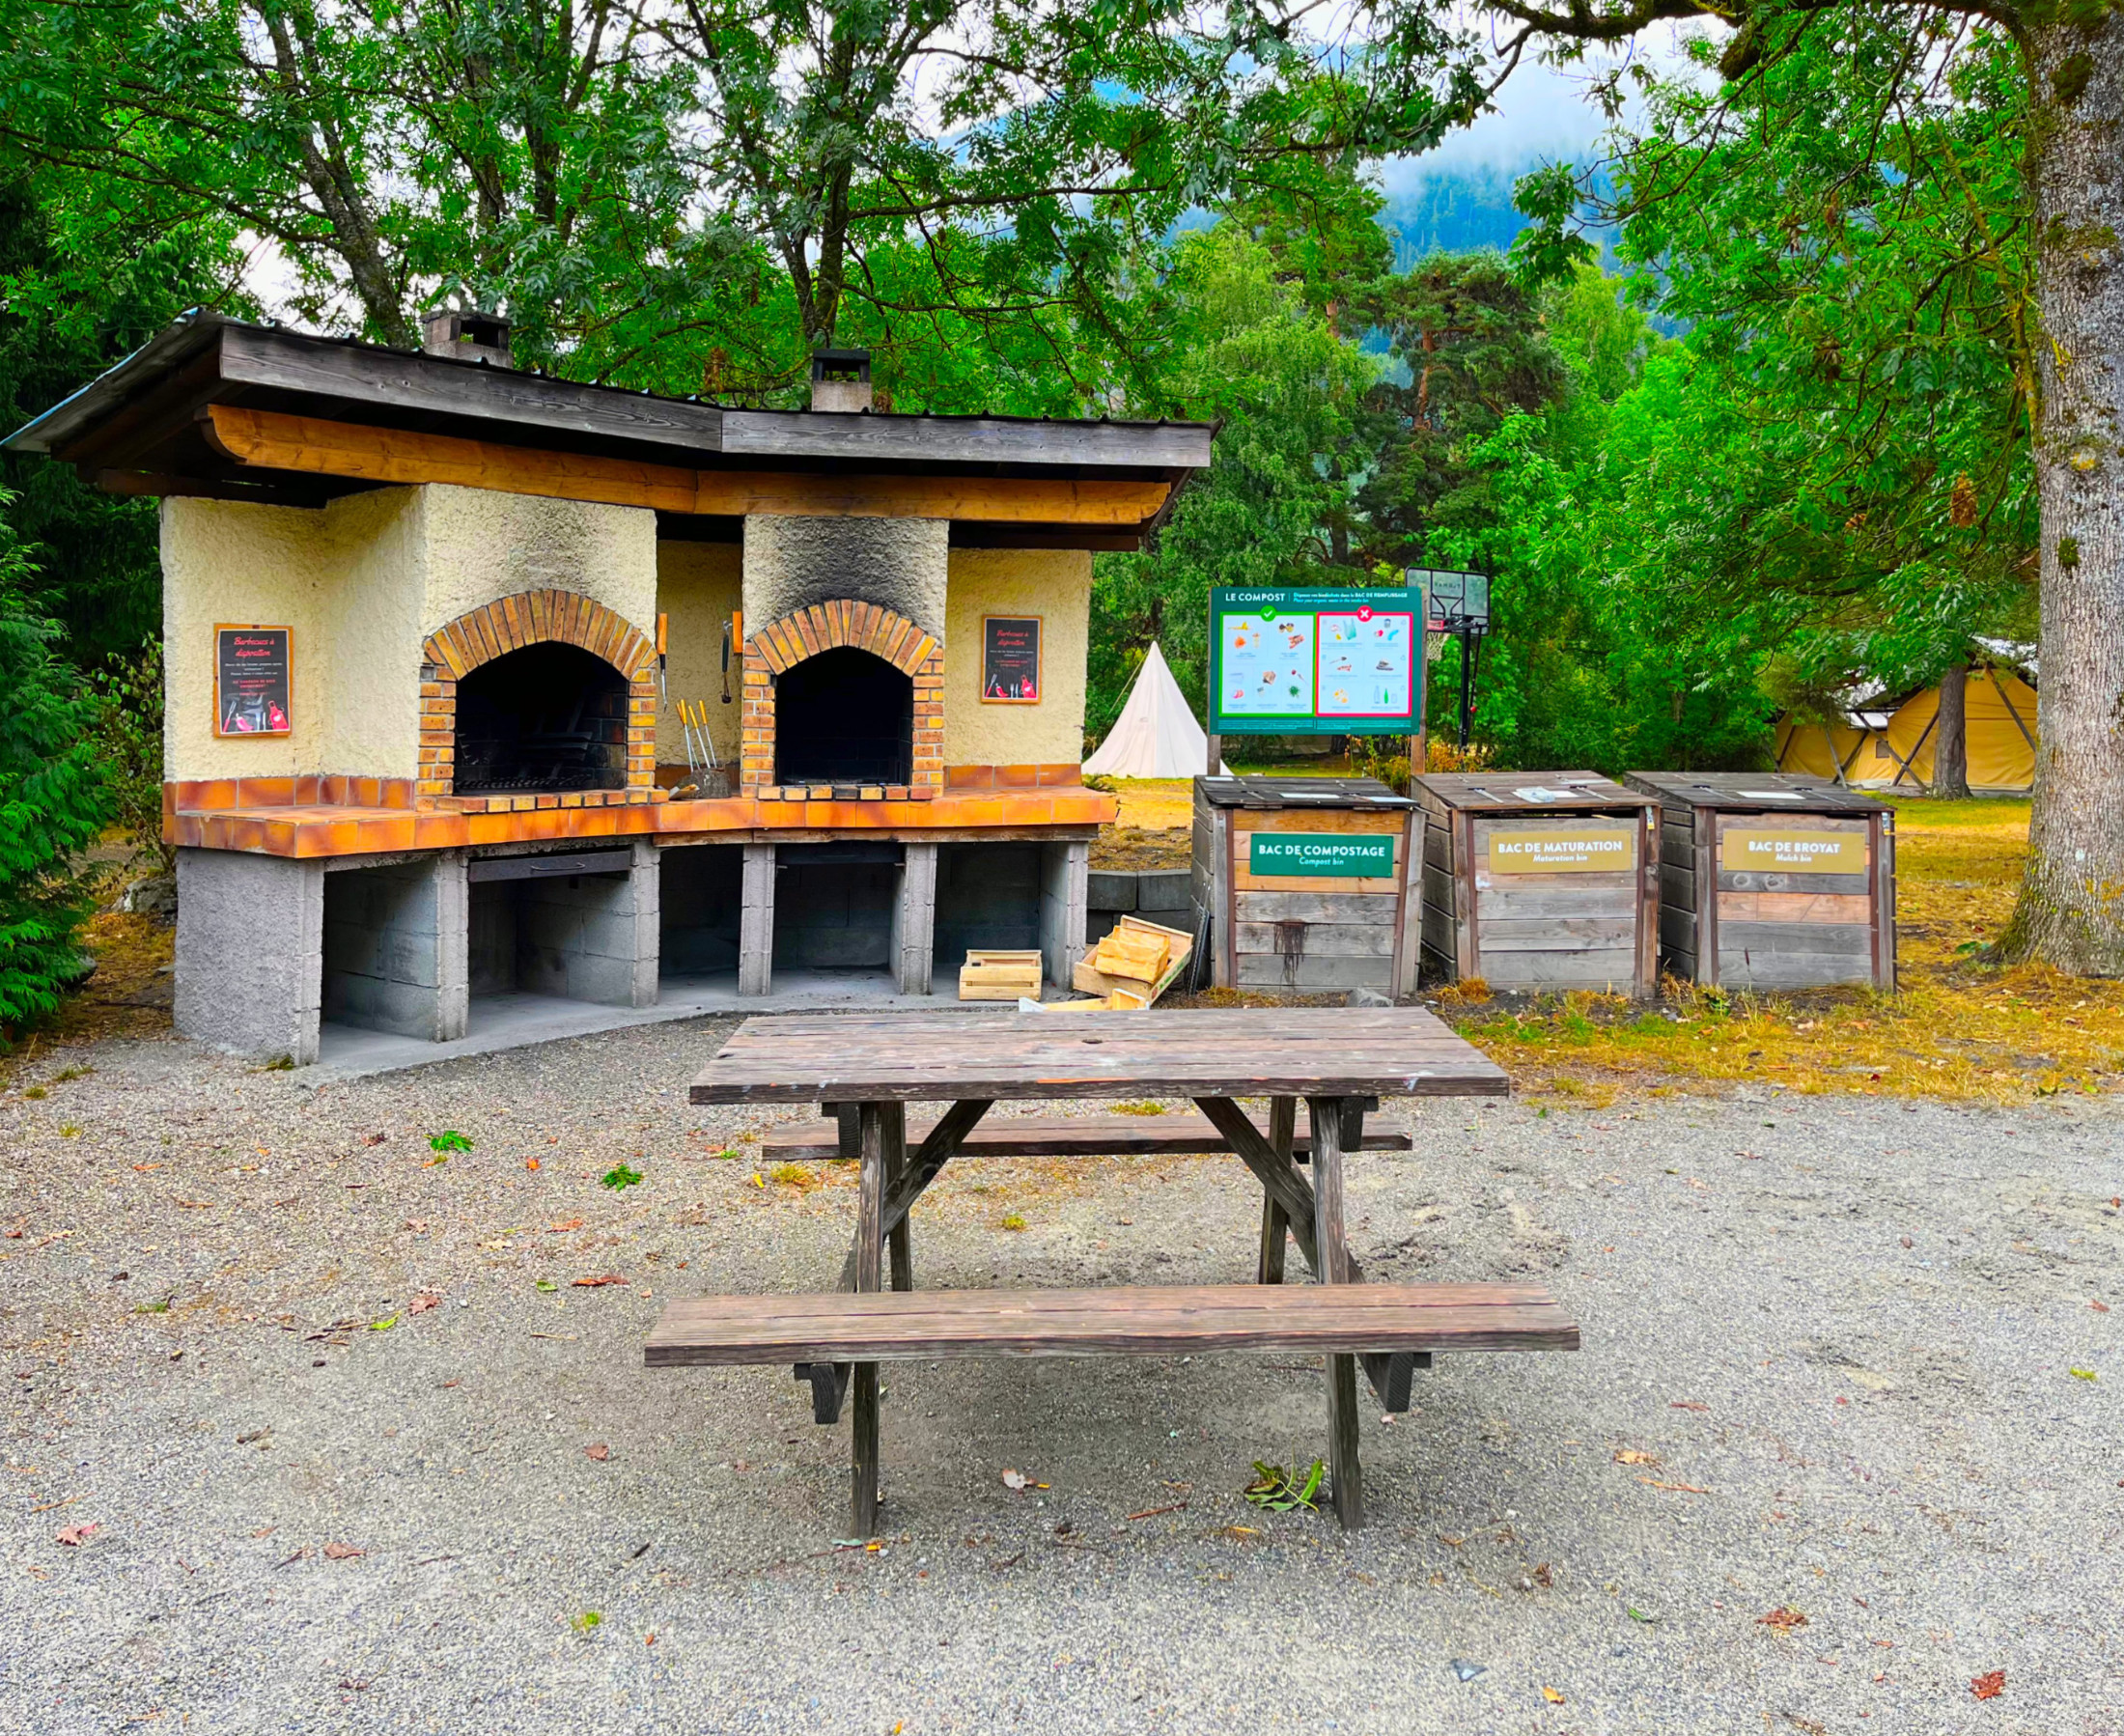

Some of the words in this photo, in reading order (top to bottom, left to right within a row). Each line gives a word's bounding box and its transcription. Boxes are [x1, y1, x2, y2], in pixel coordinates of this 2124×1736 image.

[1225, 592, 1236, 602] LE
[1238, 592, 1285, 602] COMPOST
[1258, 844, 1282, 854] BAC
[1285, 845, 1301, 855] DE
[1303, 846, 1385, 856] COMPOSTAGE
[1497, 843, 1523, 854] BAC
[1524, 842, 1541, 853] DE
[1544, 840, 1622, 853] MATURATION
[1748, 841, 1773, 852] BAC
[1775, 841, 1792, 852] DE
[1794, 842, 1840, 854] BROYAT
[1299, 856, 1331, 867] Compost
[1332, 857, 1344, 866] bin
[1533, 854, 1575, 862] Maturation
[1775, 853, 1799, 862] Mulch
[1800, 854, 1812, 862] bin
